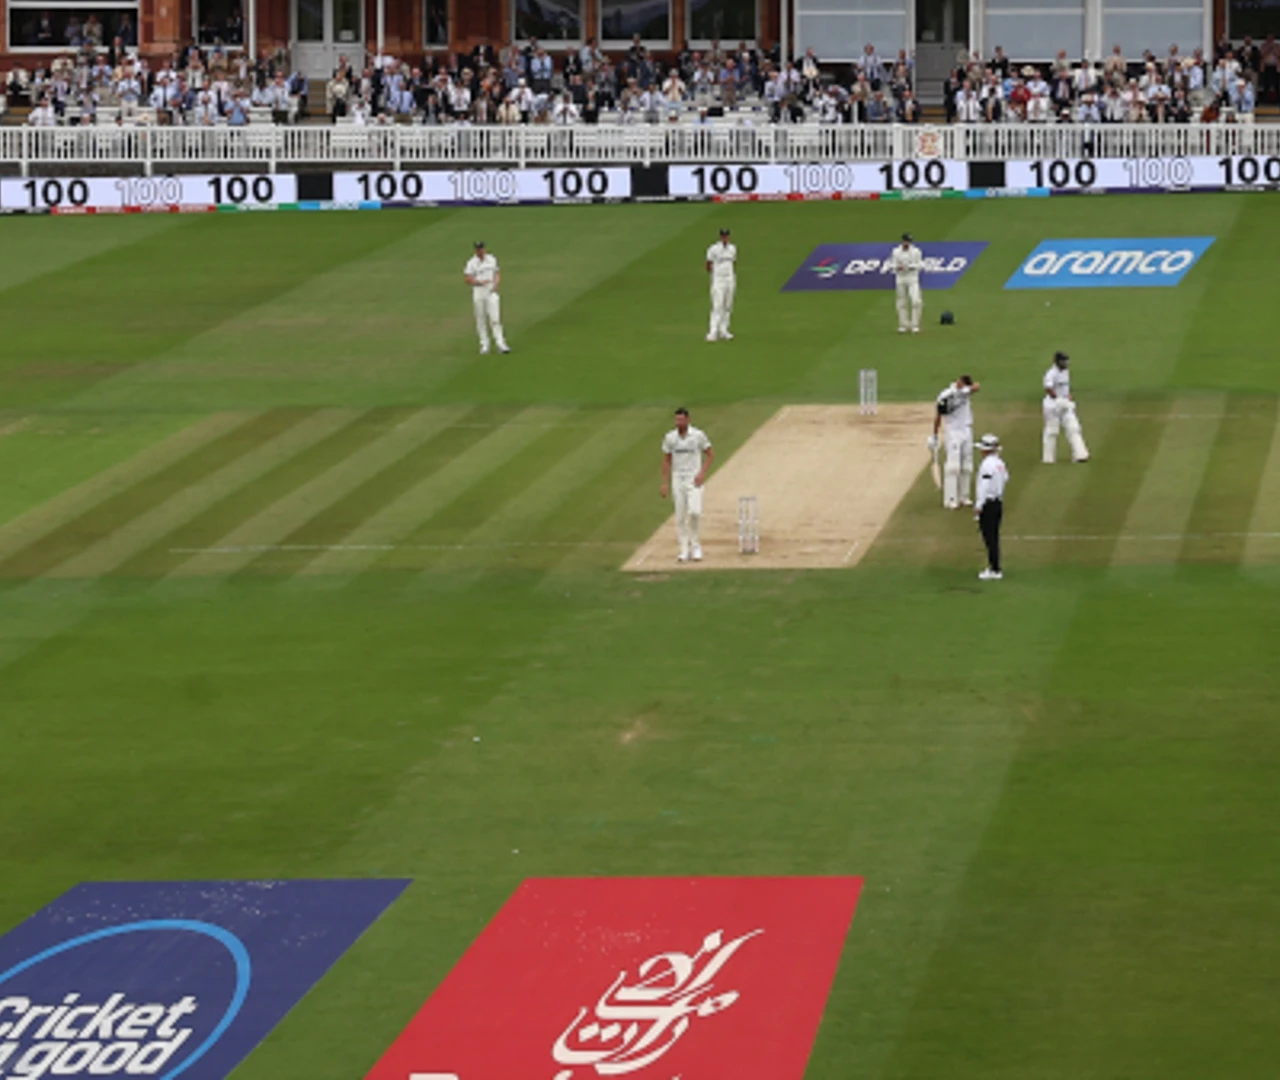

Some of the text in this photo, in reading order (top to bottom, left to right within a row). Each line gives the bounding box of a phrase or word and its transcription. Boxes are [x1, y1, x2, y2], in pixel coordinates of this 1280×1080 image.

[356, 173, 424, 200] 100
[542, 169, 609, 197] 100
[691, 167, 759, 194] 100
[879, 161, 946, 189] 100
[1029, 160, 1097, 187] 100
[23, 179, 90, 207] 100
[207, 176, 275, 203] 100
[843, 260, 880, 275] DP
[1022, 249, 1196, 277] aramco
